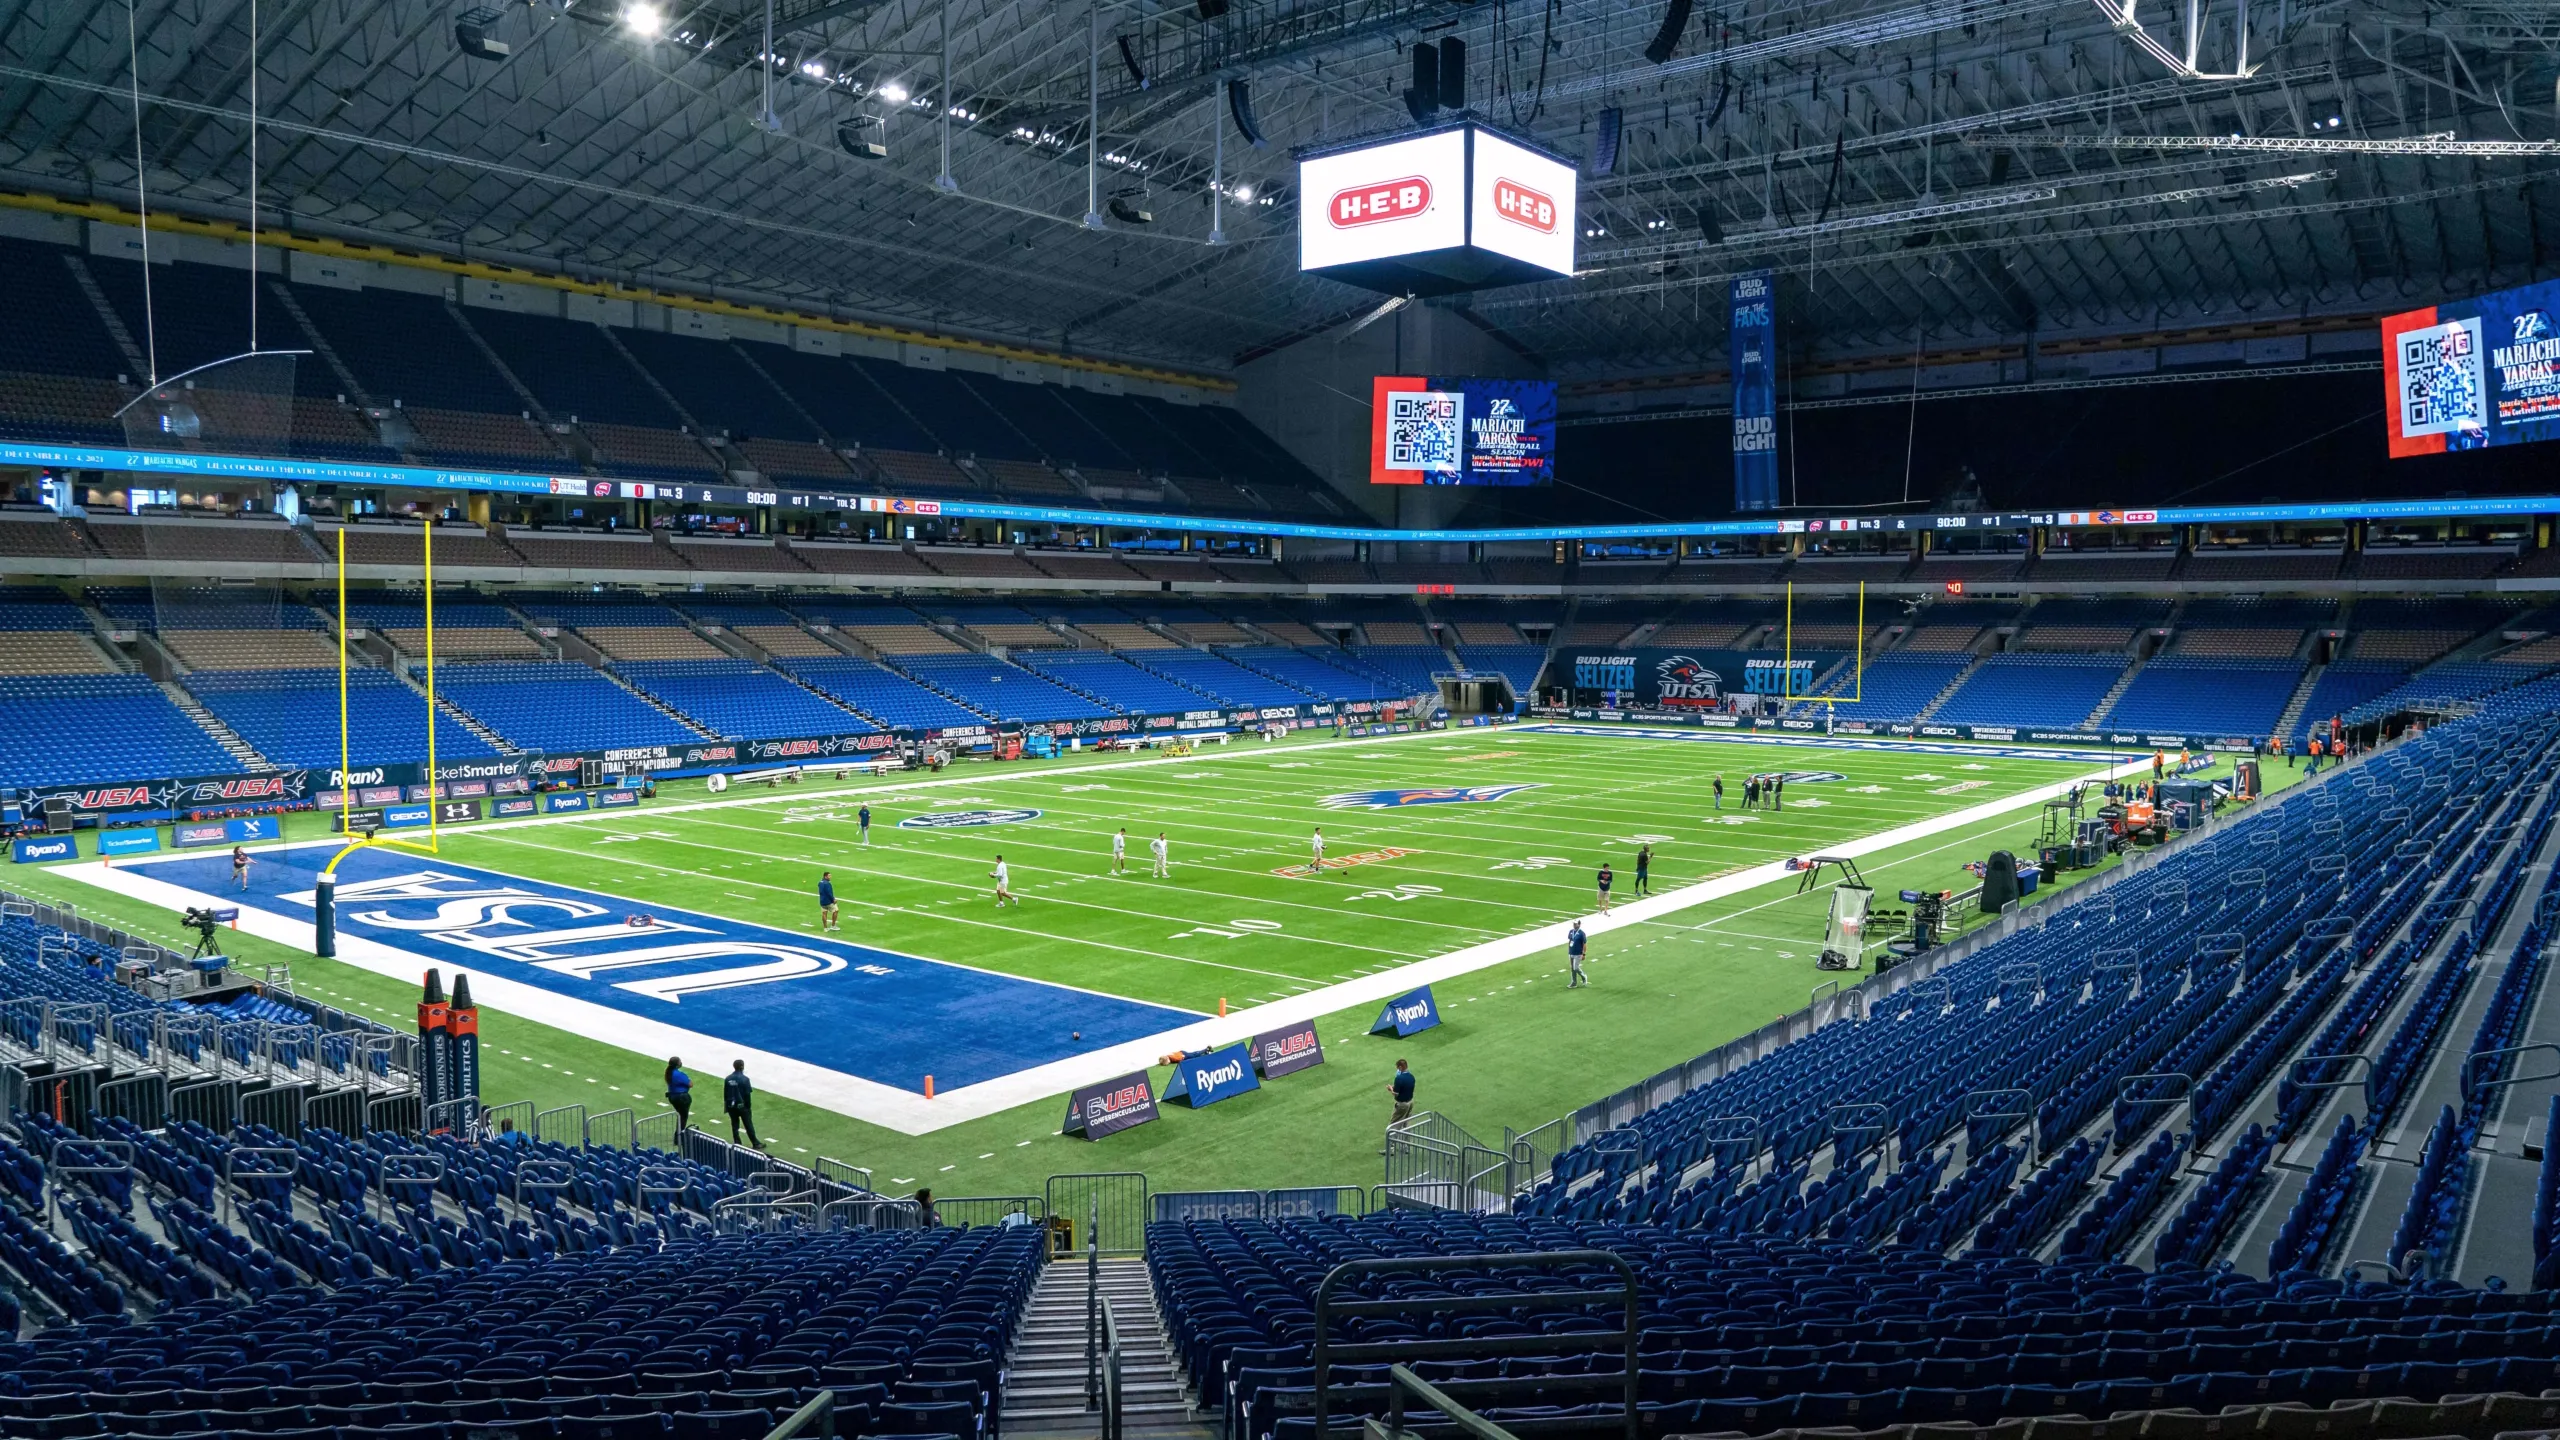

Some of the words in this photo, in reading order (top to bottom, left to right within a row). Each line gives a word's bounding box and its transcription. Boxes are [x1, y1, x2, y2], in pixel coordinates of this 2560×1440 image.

[1739, 278, 1762, 290] BUD
[1735, 286, 1767, 299] LIGHT
[1752, 302, 1766, 312] THE
[1735, 310, 1769, 328] FANS
[2513, 313, 2538, 339] 27
[2493, 337, 2560, 368] MARIACHI
[2503, 360, 2553, 385] VARGAS
[1490, 400, 1510, 415] 27
[1471, 418, 1525, 433] MARIACHI
[1735, 416, 1773, 435] BUD
[1478, 432, 1517, 445] VARGAS
[1733, 433, 1776, 452] LIGHT
[5, 450, 62, 460] DECEMBER
[127, 456, 139, 464] 27
[327, 469, 372, 478] DECEMBER
[634, 484, 644, 498] 0
[658, 488, 673, 497] TOL
[675, 488, 683, 500] 3
[703, 490, 712, 502] &
[747, 492, 776, 505] 90:00
[792, 496, 802, 505] QT
[804, 496, 809, 507] 1
[836, 499, 848, 508] TOL
[850, 499, 856, 510] 3
[1874, 520, 1880, 528] 3
[1897, 520, 1906, 529] &
[1937, 517, 1966, 528] 90:00
[1982, 517, 1992, 526] QT
[1995, 516, 2000, 526] 1
[2030, 515, 2043, 524] TOL
[2046, 514, 2053, 524] 3
[1947, 582, 1961, 593] 40
[1576, 656, 1600, 664] BUD
[1602, 656, 1636, 666] LIGHT
[1746, 660, 1774, 668] BUD
[1575, 665, 1635, 690] SELTZER
[1744, 669, 1813, 694] SELTZER
[1664, 683, 1716, 698] UTSA
[1185, 711, 1210, 720] CONFERENCE
[1261, 708, 1296, 719] GEICO
[1176, 720, 1196, 730] FOOTBALL
[1198, 718, 1226, 728] CHAMPIONSHIP
[1782, 720, 1814, 728] GEICO
[1891, 724, 1908, 734] Ryan
[942, 727, 974, 738] CONFERENCE
[976, 726, 986, 736] USA
[1922, 726, 1956, 736] GEICO
[604, 747, 652, 762] CONFERENCE
[653, 746, 668, 759] USA
[423, 764, 520, 781] TcketSmarter
[554, 798, 576, 809] Ryan
[390, 811, 428, 821] GEICO
[604, 830, 680, 842] 10
[26, 845, 58, 858] Ryan
[1502, 856, 1572, 870] 30
[1361, 884, 1443, 902] 20
[1197, 918, 1284, 940] 10
[1397, 1000, 1422, 1026] Ryan
[1266, 1047, 1318, 1068] CONFERENCEUSA.COM
[462, 1039, 473, 1100] ATHLETICS
[434, 1034, 448, 1121] ROADRUNNERS
[1196, 1065, 1231, 1093] Ryan
[1090, 1103, 1150, 1127] CONFERENCEUSA.COM
